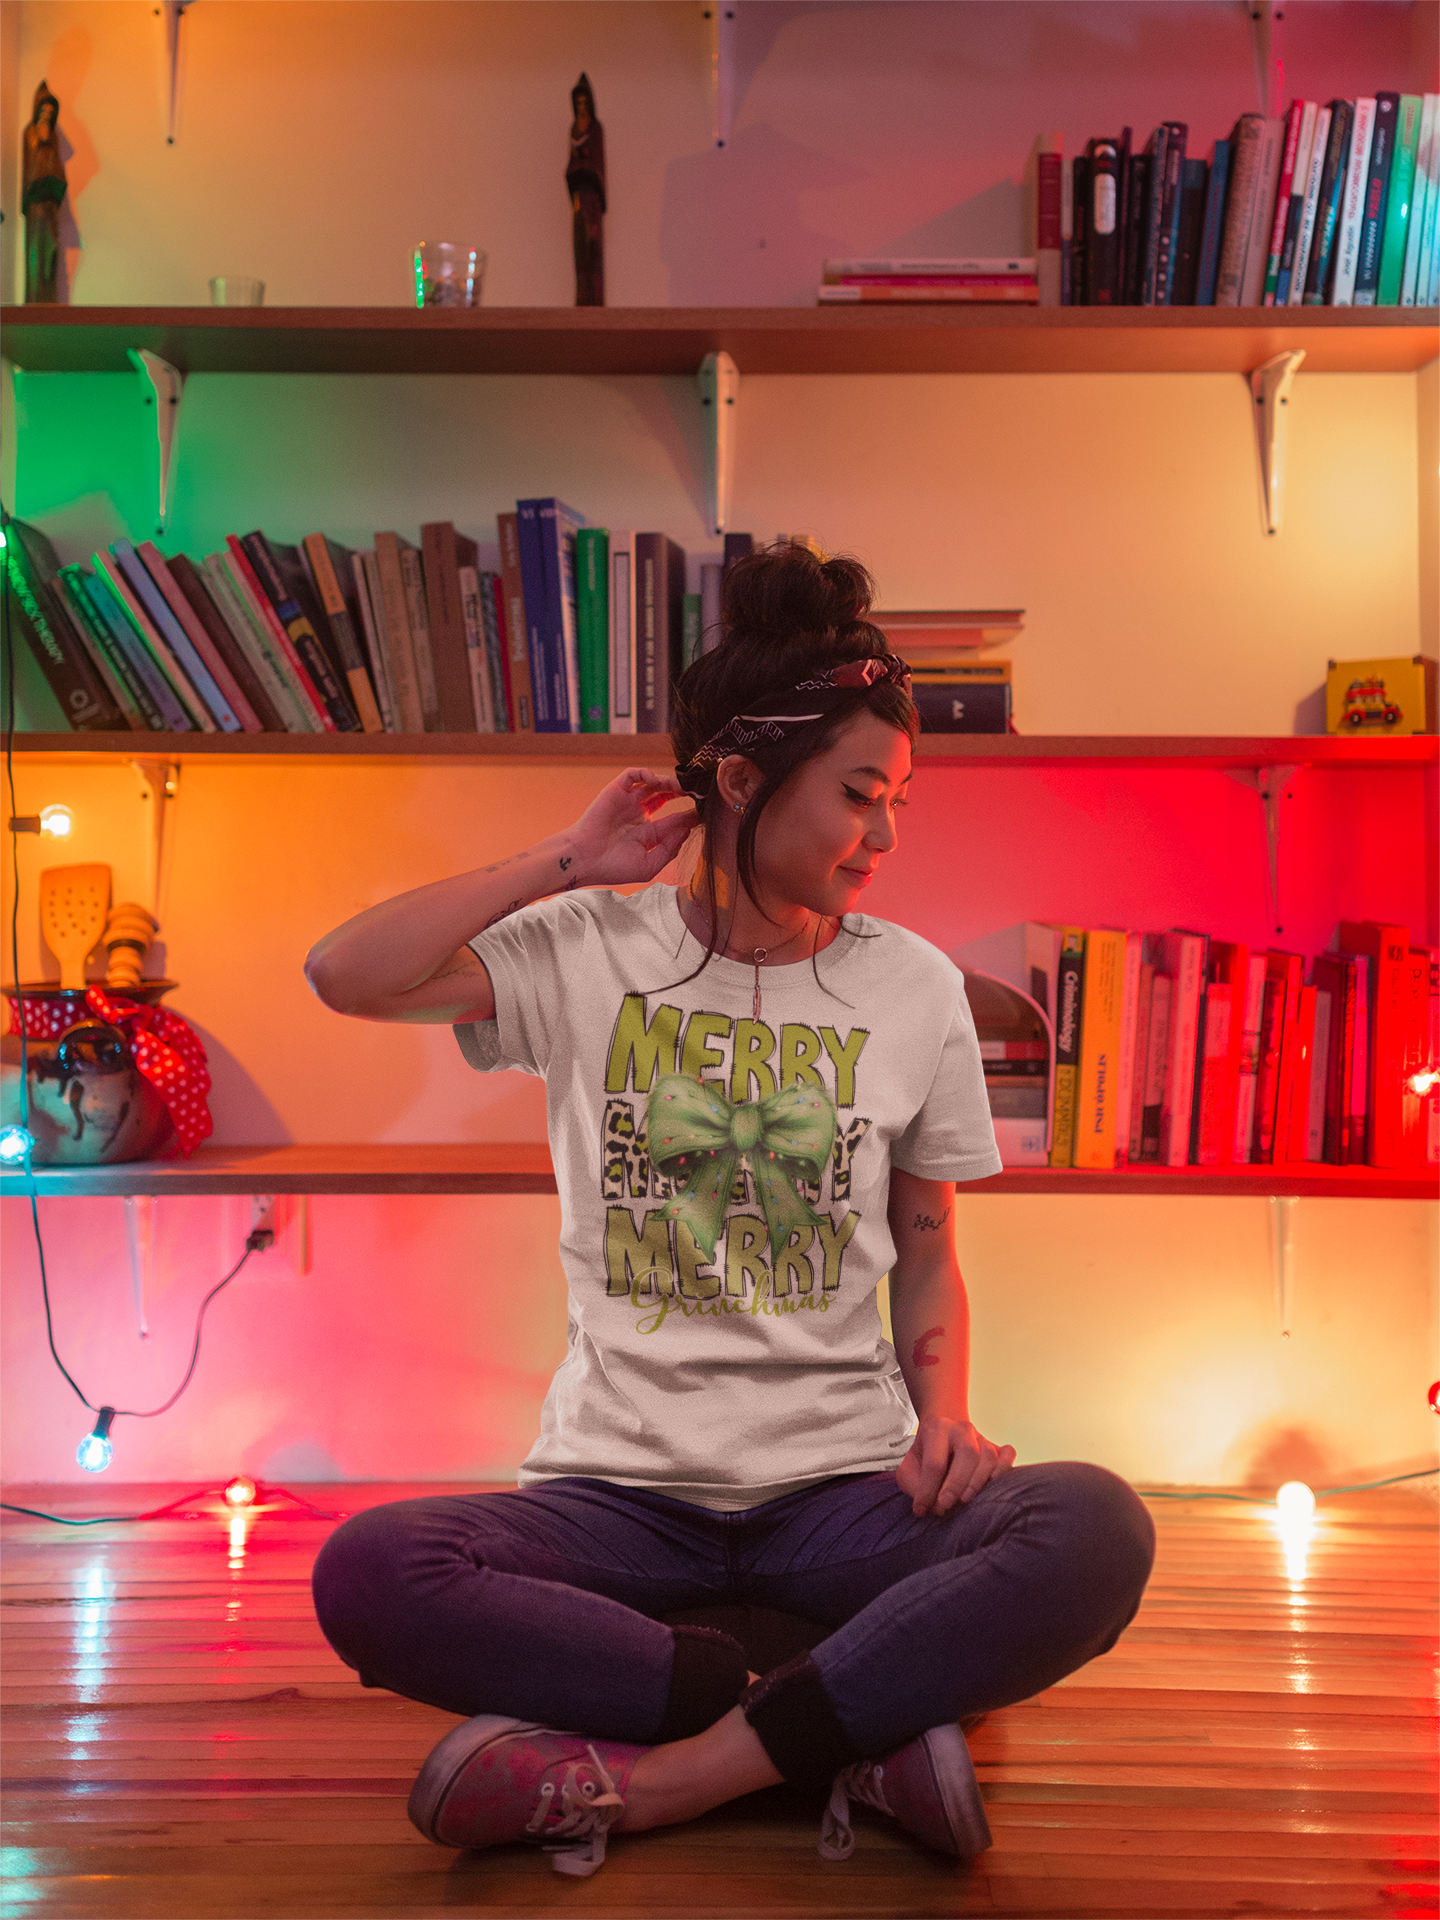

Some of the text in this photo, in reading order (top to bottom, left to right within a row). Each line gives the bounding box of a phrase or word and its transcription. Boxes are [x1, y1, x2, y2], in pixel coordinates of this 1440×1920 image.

[604, 991, 871, 1110] MERRY
[1056, 970, 1078, 1053] Criminology
[1054, 1077, 1072, 1147] DUMMIES
[1093, 1053, 1106, 1133] PSICÓPOLIS
[603, 1204, 862, 1300] MERRY
[630, 1265, 837, 1335] Grinchmas
